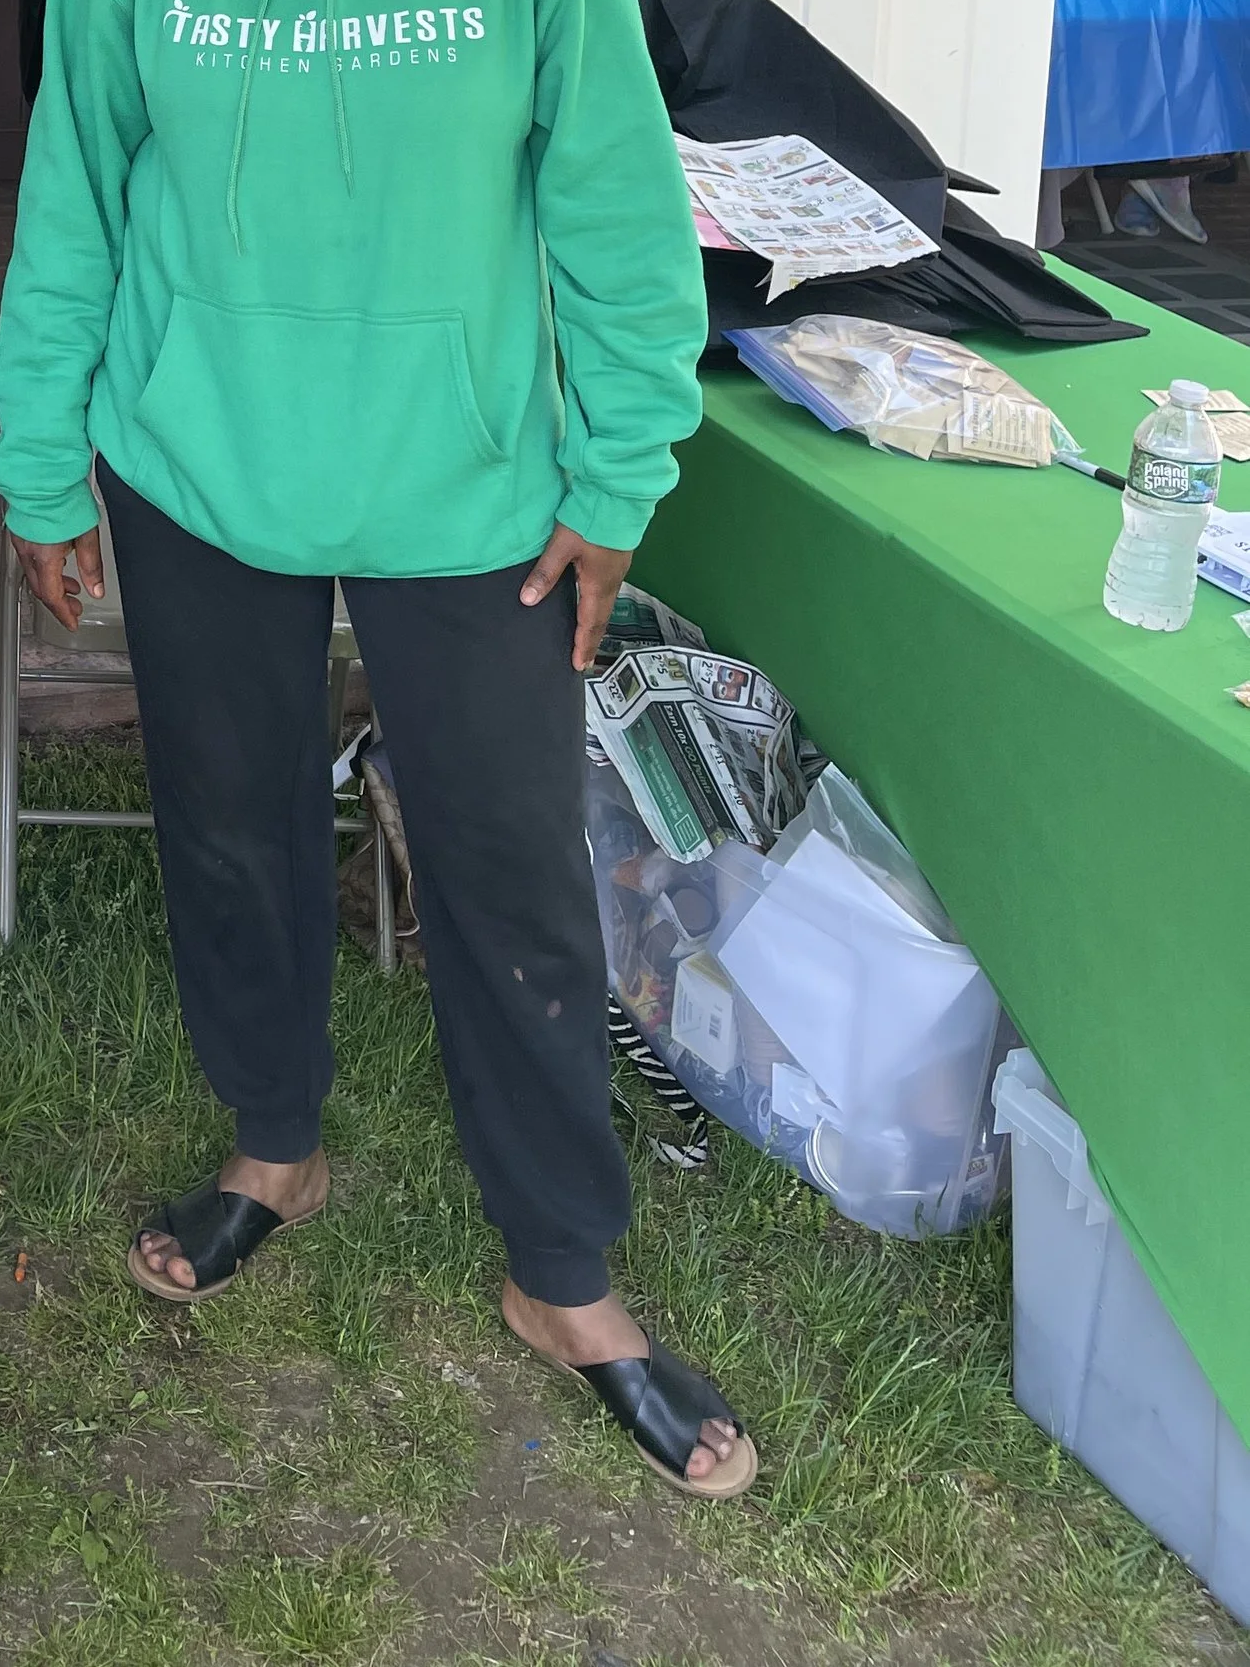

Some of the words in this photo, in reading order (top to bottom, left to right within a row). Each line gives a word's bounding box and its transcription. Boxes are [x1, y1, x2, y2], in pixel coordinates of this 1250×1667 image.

[163, 9, 281, 51] TASTY
[292, 7, 486, 53] HARVESTS
[196, 52, 310, 73] KITCHEN
[1145, 462, 1189, 479] Poland
[1144, 475, 1189, 491] Spring
[664, 704, 678, 729] Earn
